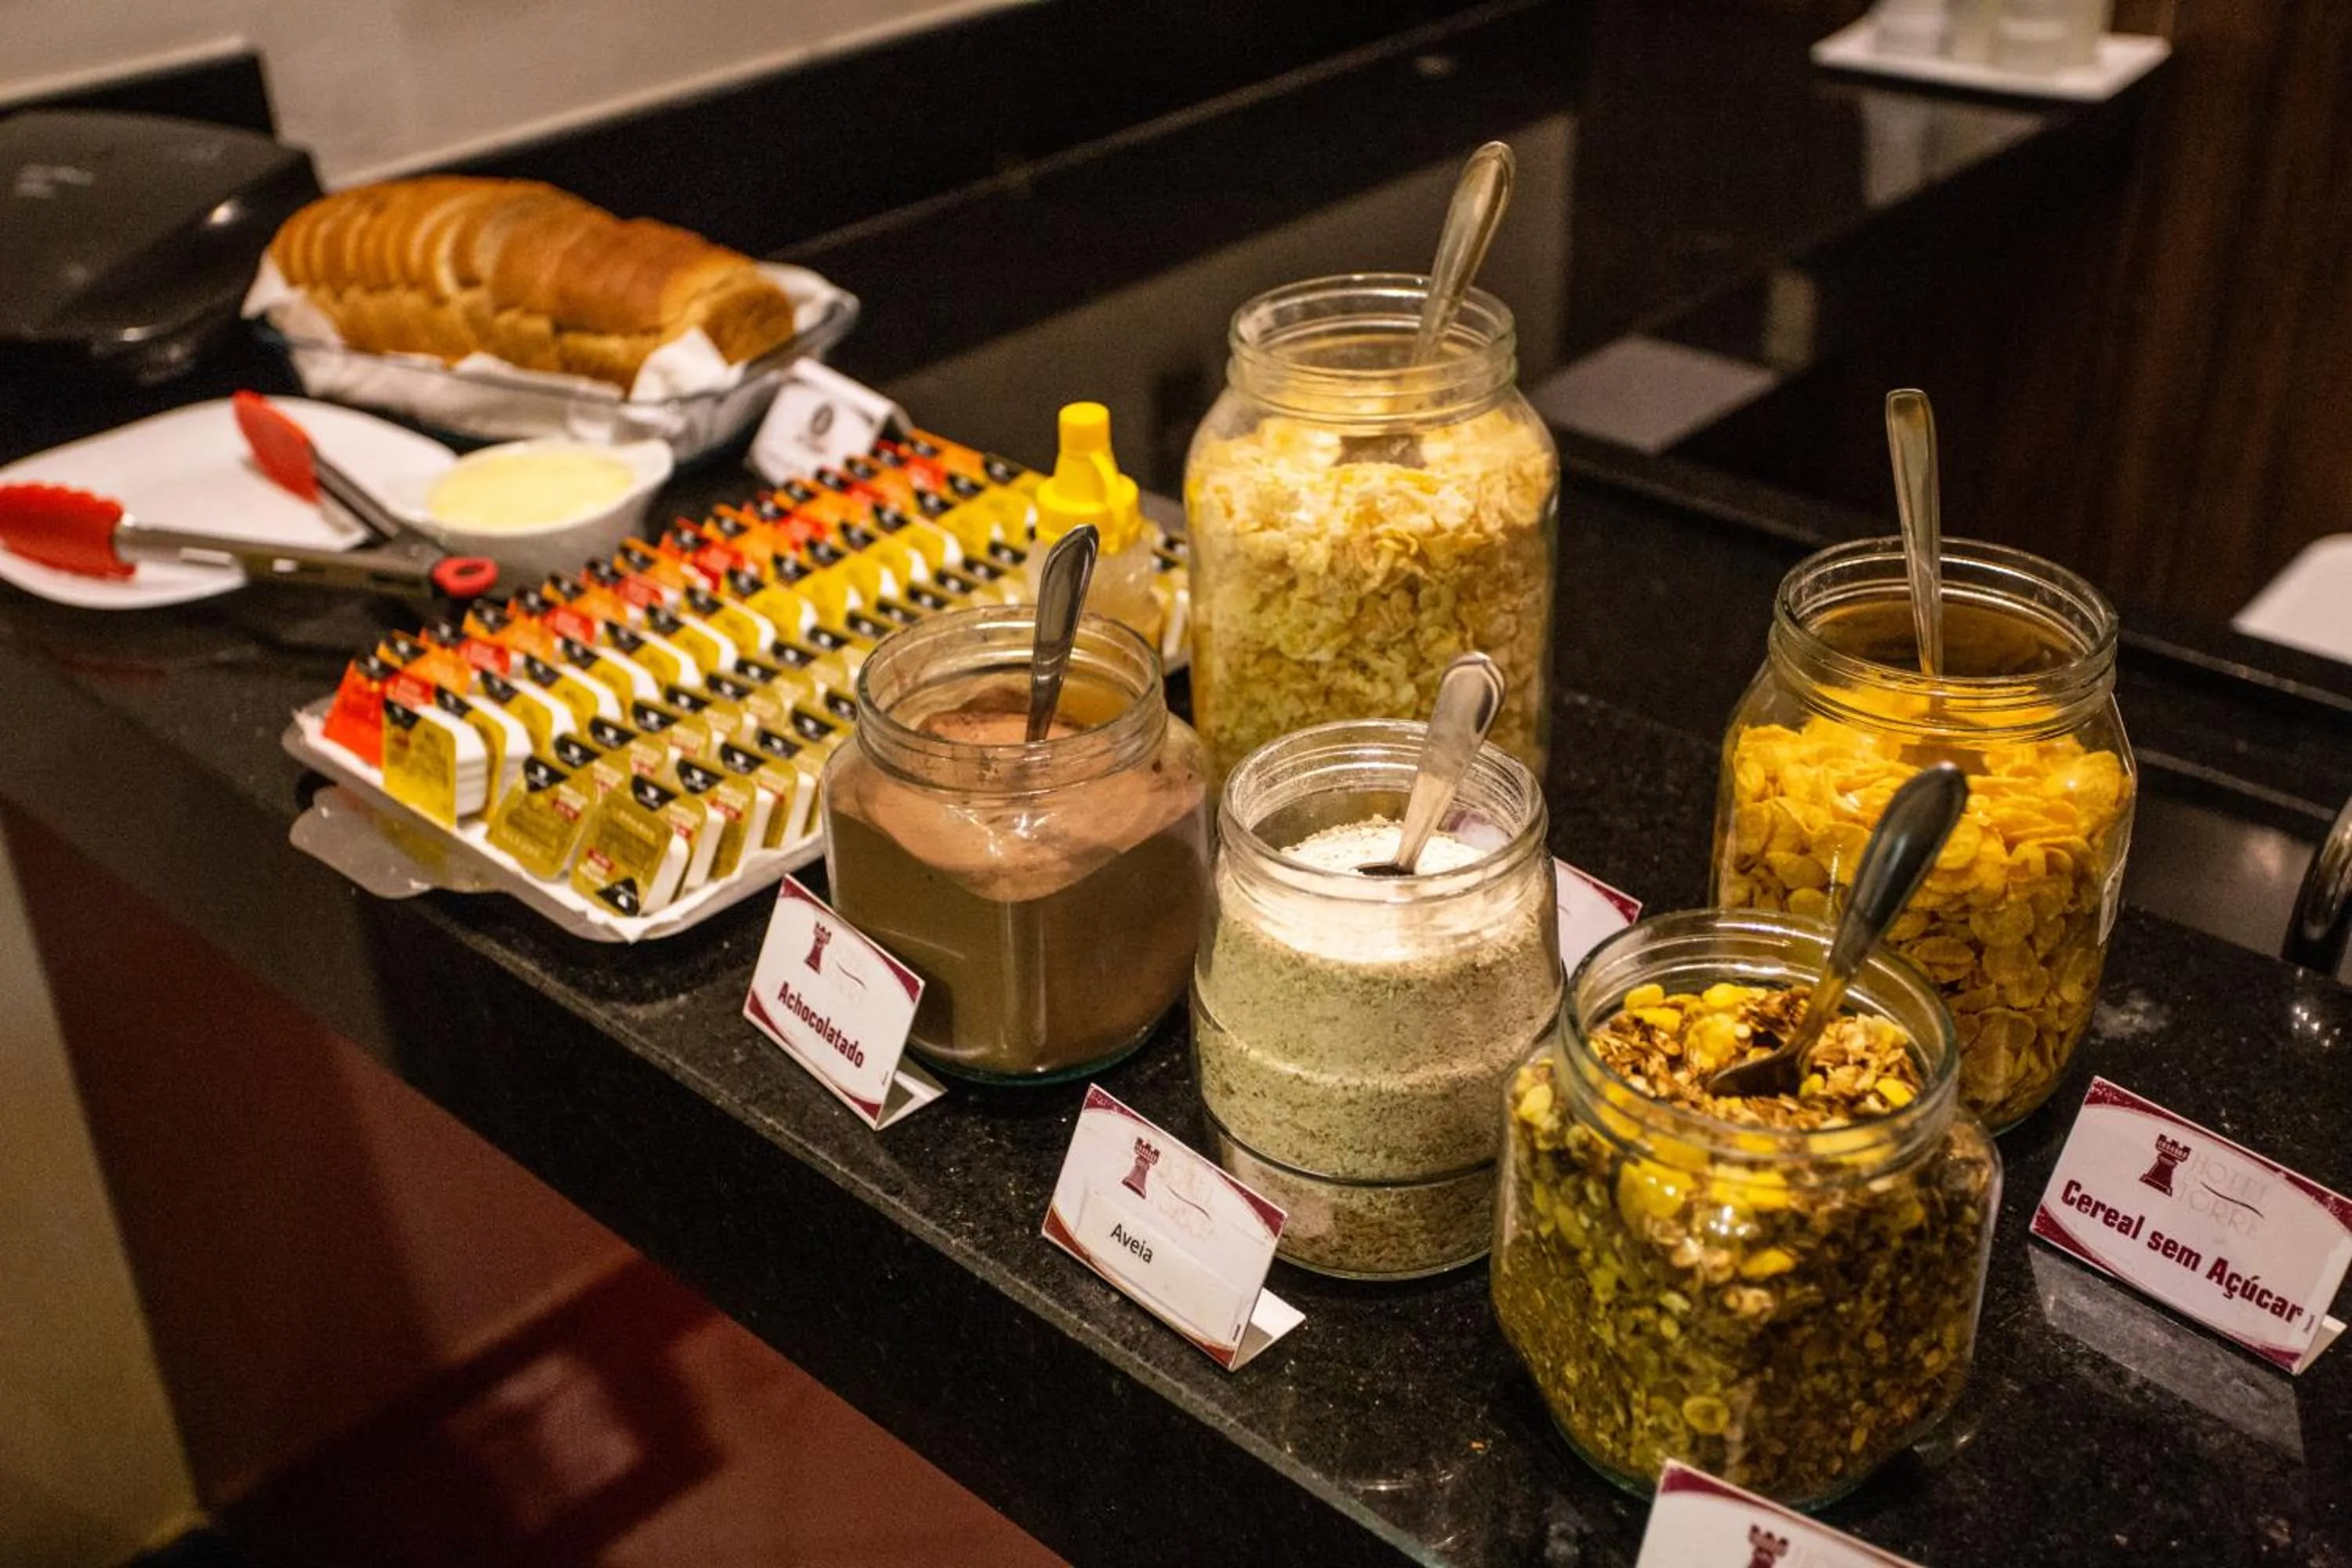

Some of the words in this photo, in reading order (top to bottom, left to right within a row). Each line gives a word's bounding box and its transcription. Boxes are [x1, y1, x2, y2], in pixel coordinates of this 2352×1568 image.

[777, 981, 865, 1069] Achocolatado
[1109, 1223, 1153, 1264] Aveia
[2060, 1179, 2146, 1240] Cereal
[2147, 1230, 2202, 1272] sem
[2205, 1257, 2304, 1323] Açúcar
